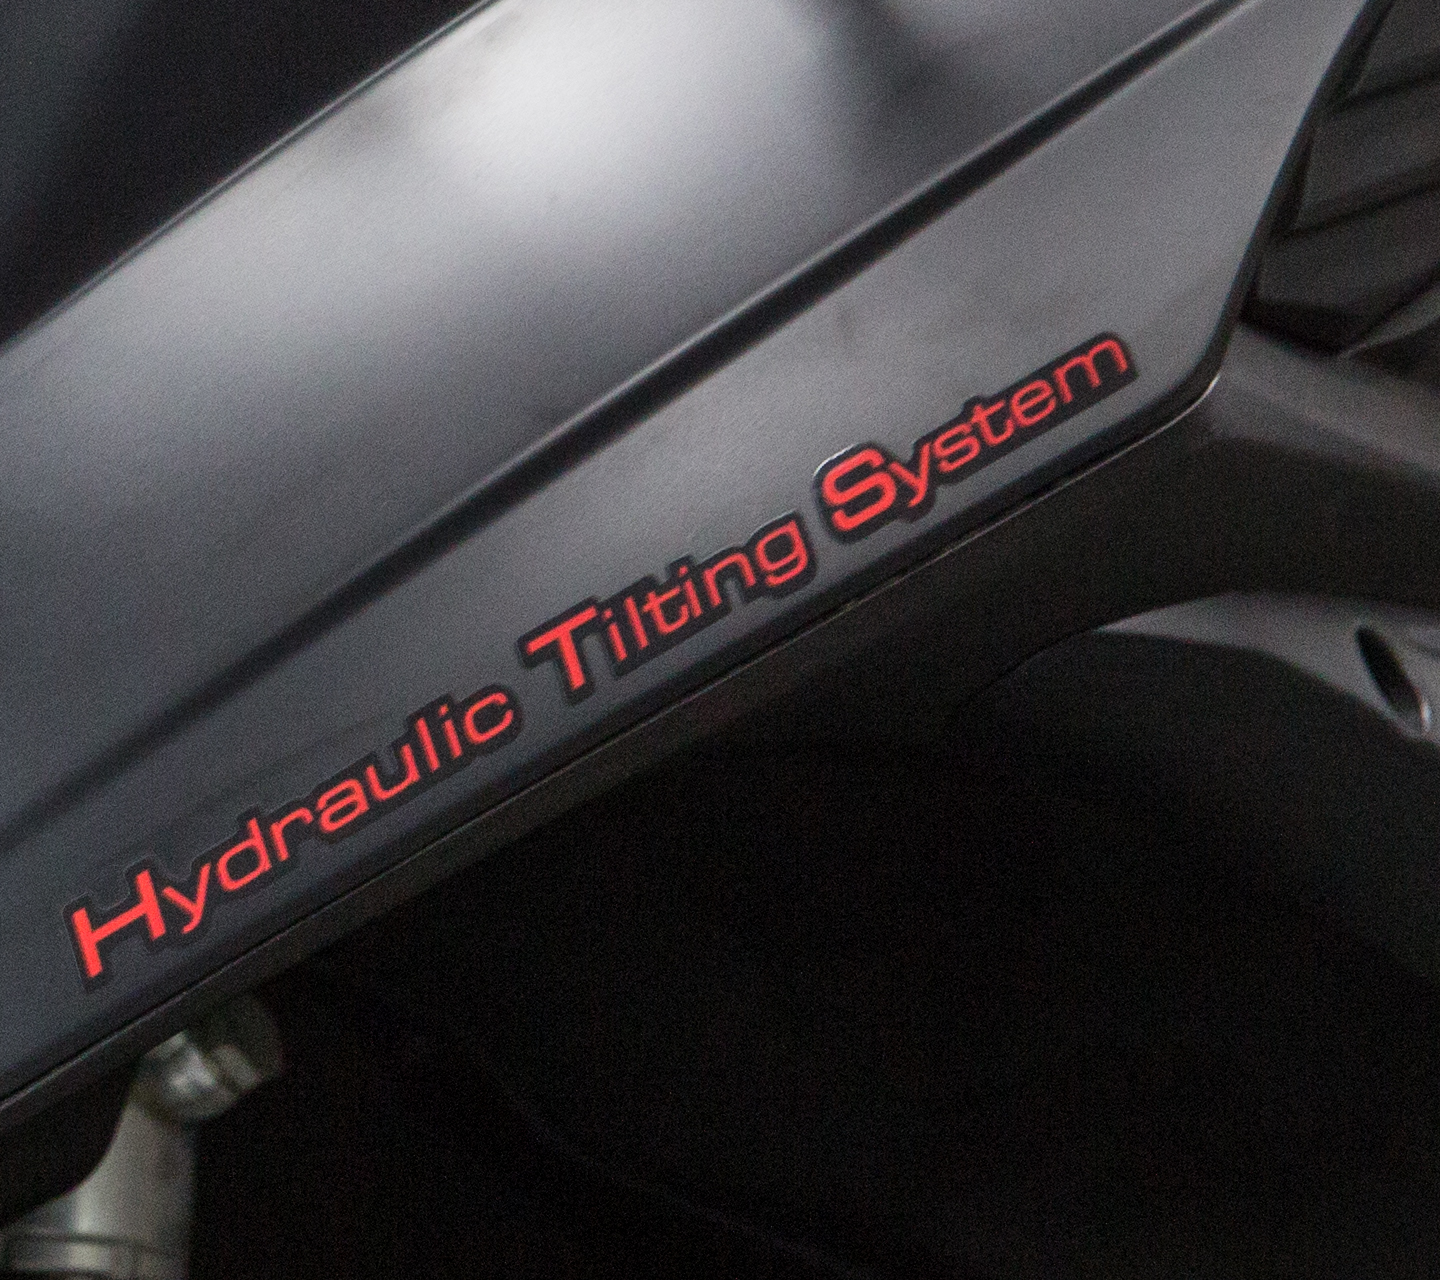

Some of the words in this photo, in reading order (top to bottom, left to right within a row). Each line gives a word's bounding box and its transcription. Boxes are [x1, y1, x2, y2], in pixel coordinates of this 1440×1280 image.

[71, 692, 515, 979] Hydraulic
[525, 520, 810, 690] Tilting
[820, 336, 1130, 533] System
